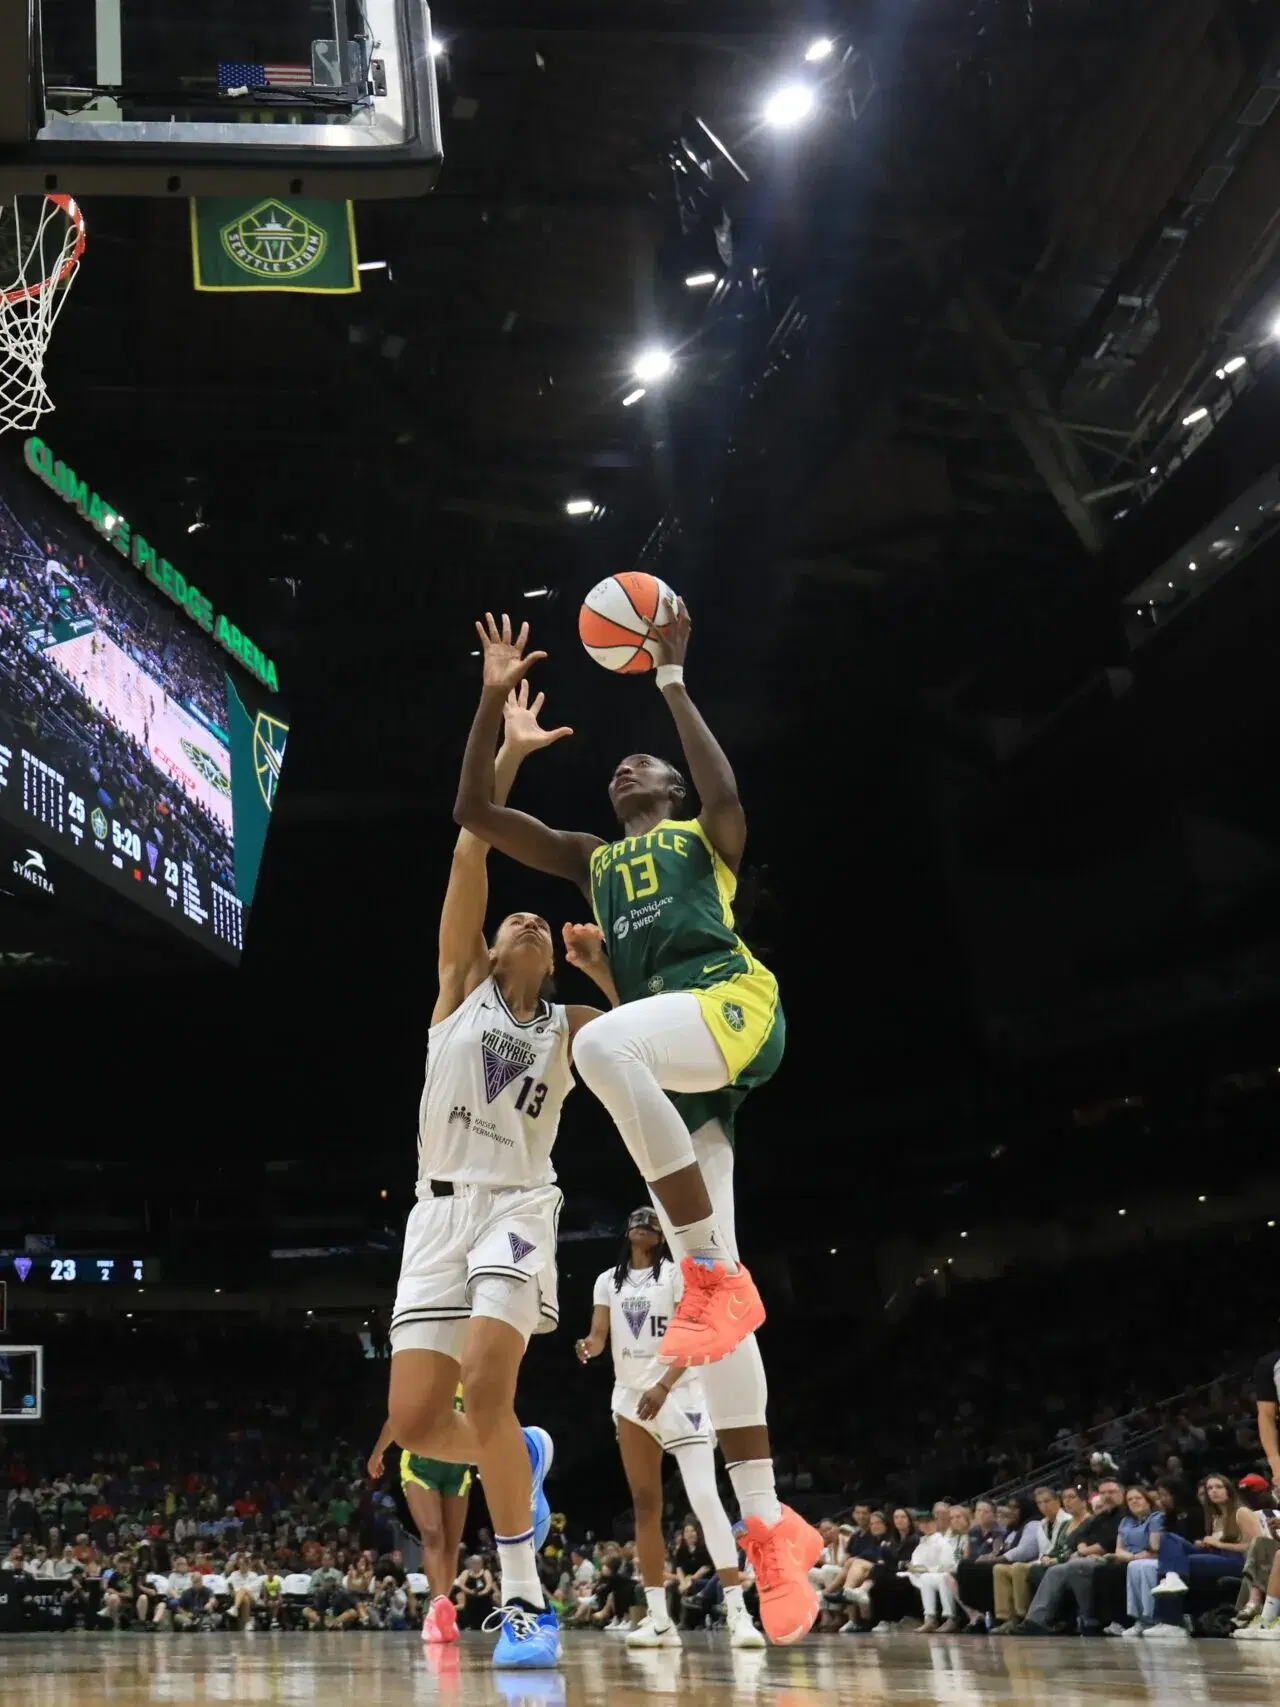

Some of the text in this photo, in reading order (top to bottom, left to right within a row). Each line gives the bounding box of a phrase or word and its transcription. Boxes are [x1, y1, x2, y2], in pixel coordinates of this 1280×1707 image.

[228, 233, 320, 272] SEATTLE STORM
[23, 436, 279, 693] CLIMATE PLEDGE ARENA
[68, 791, 86, 824] 25
[112, 819, 141, 861] 5:20
[164, 857, 179, 887] 23
[595, 832, 689, 887] SEATTLE
[13, 860, 55, 895] SYMETRA
[614, 852, 659, 903] 13
[481, 1030, 537, 1066] VALKYRIES
[514, 1075, 549, 1119] 13
[472, 1125, 515, 1148] PERMANENTE
[474, 1118, 496, 1131] KAISER
[50, 1259, 77, 1281] 23
[101, 1268, 110, 1281] 2
[650, 1315, 669, 1338] 15
